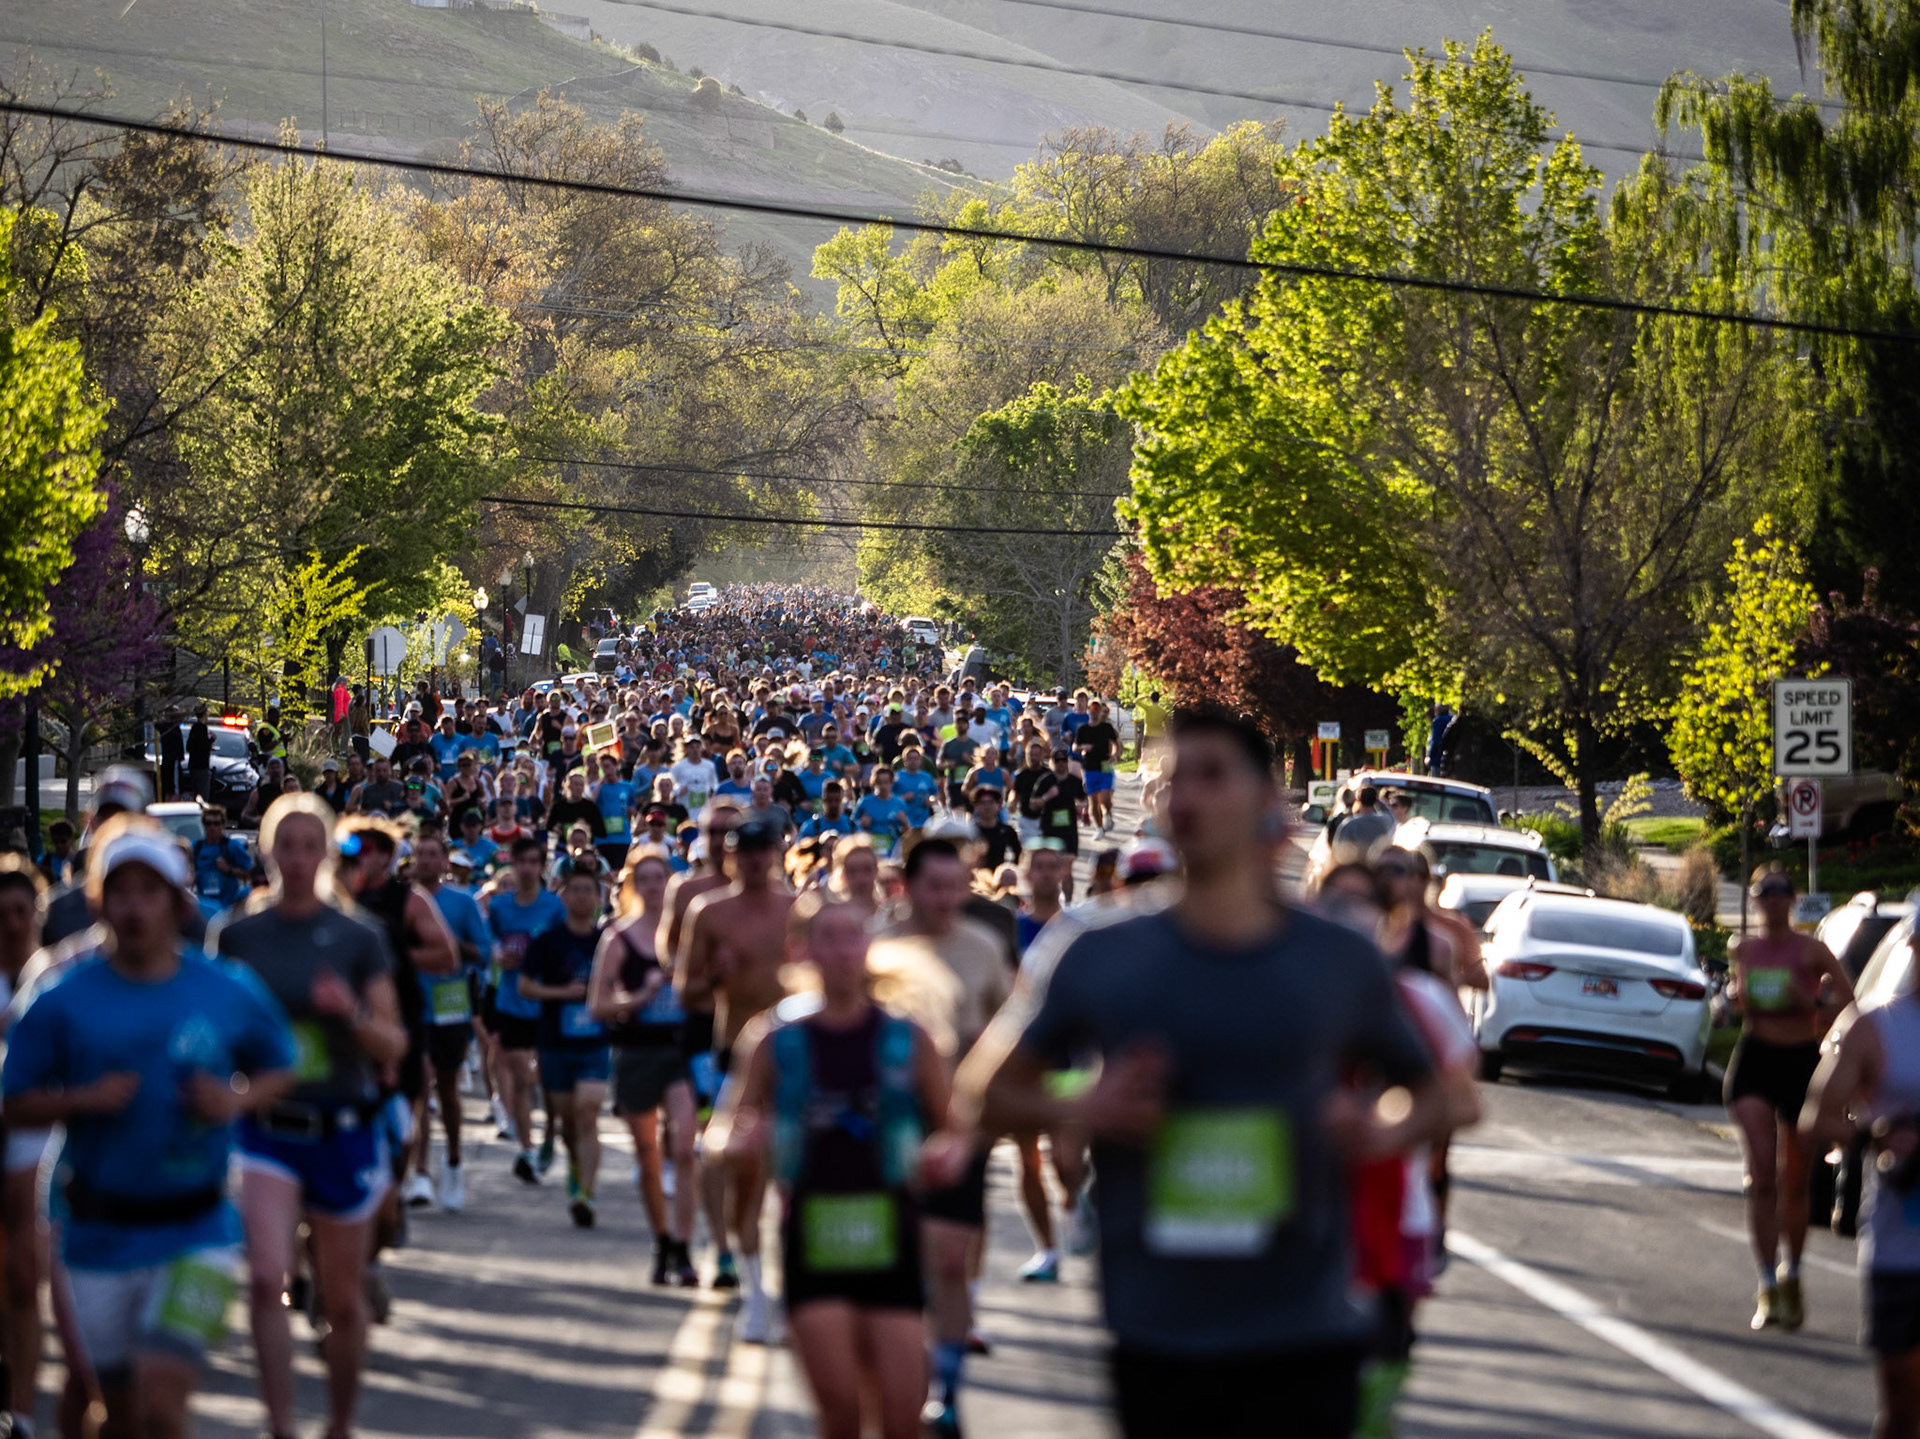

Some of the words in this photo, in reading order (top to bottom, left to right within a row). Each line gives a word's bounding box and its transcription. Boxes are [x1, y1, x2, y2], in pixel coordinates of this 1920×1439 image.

[1784, 691, 1840, 706] SPEED
[1790, 711, 1833, 726] LIMIT
[1784, 730, 1840, 765] 25
